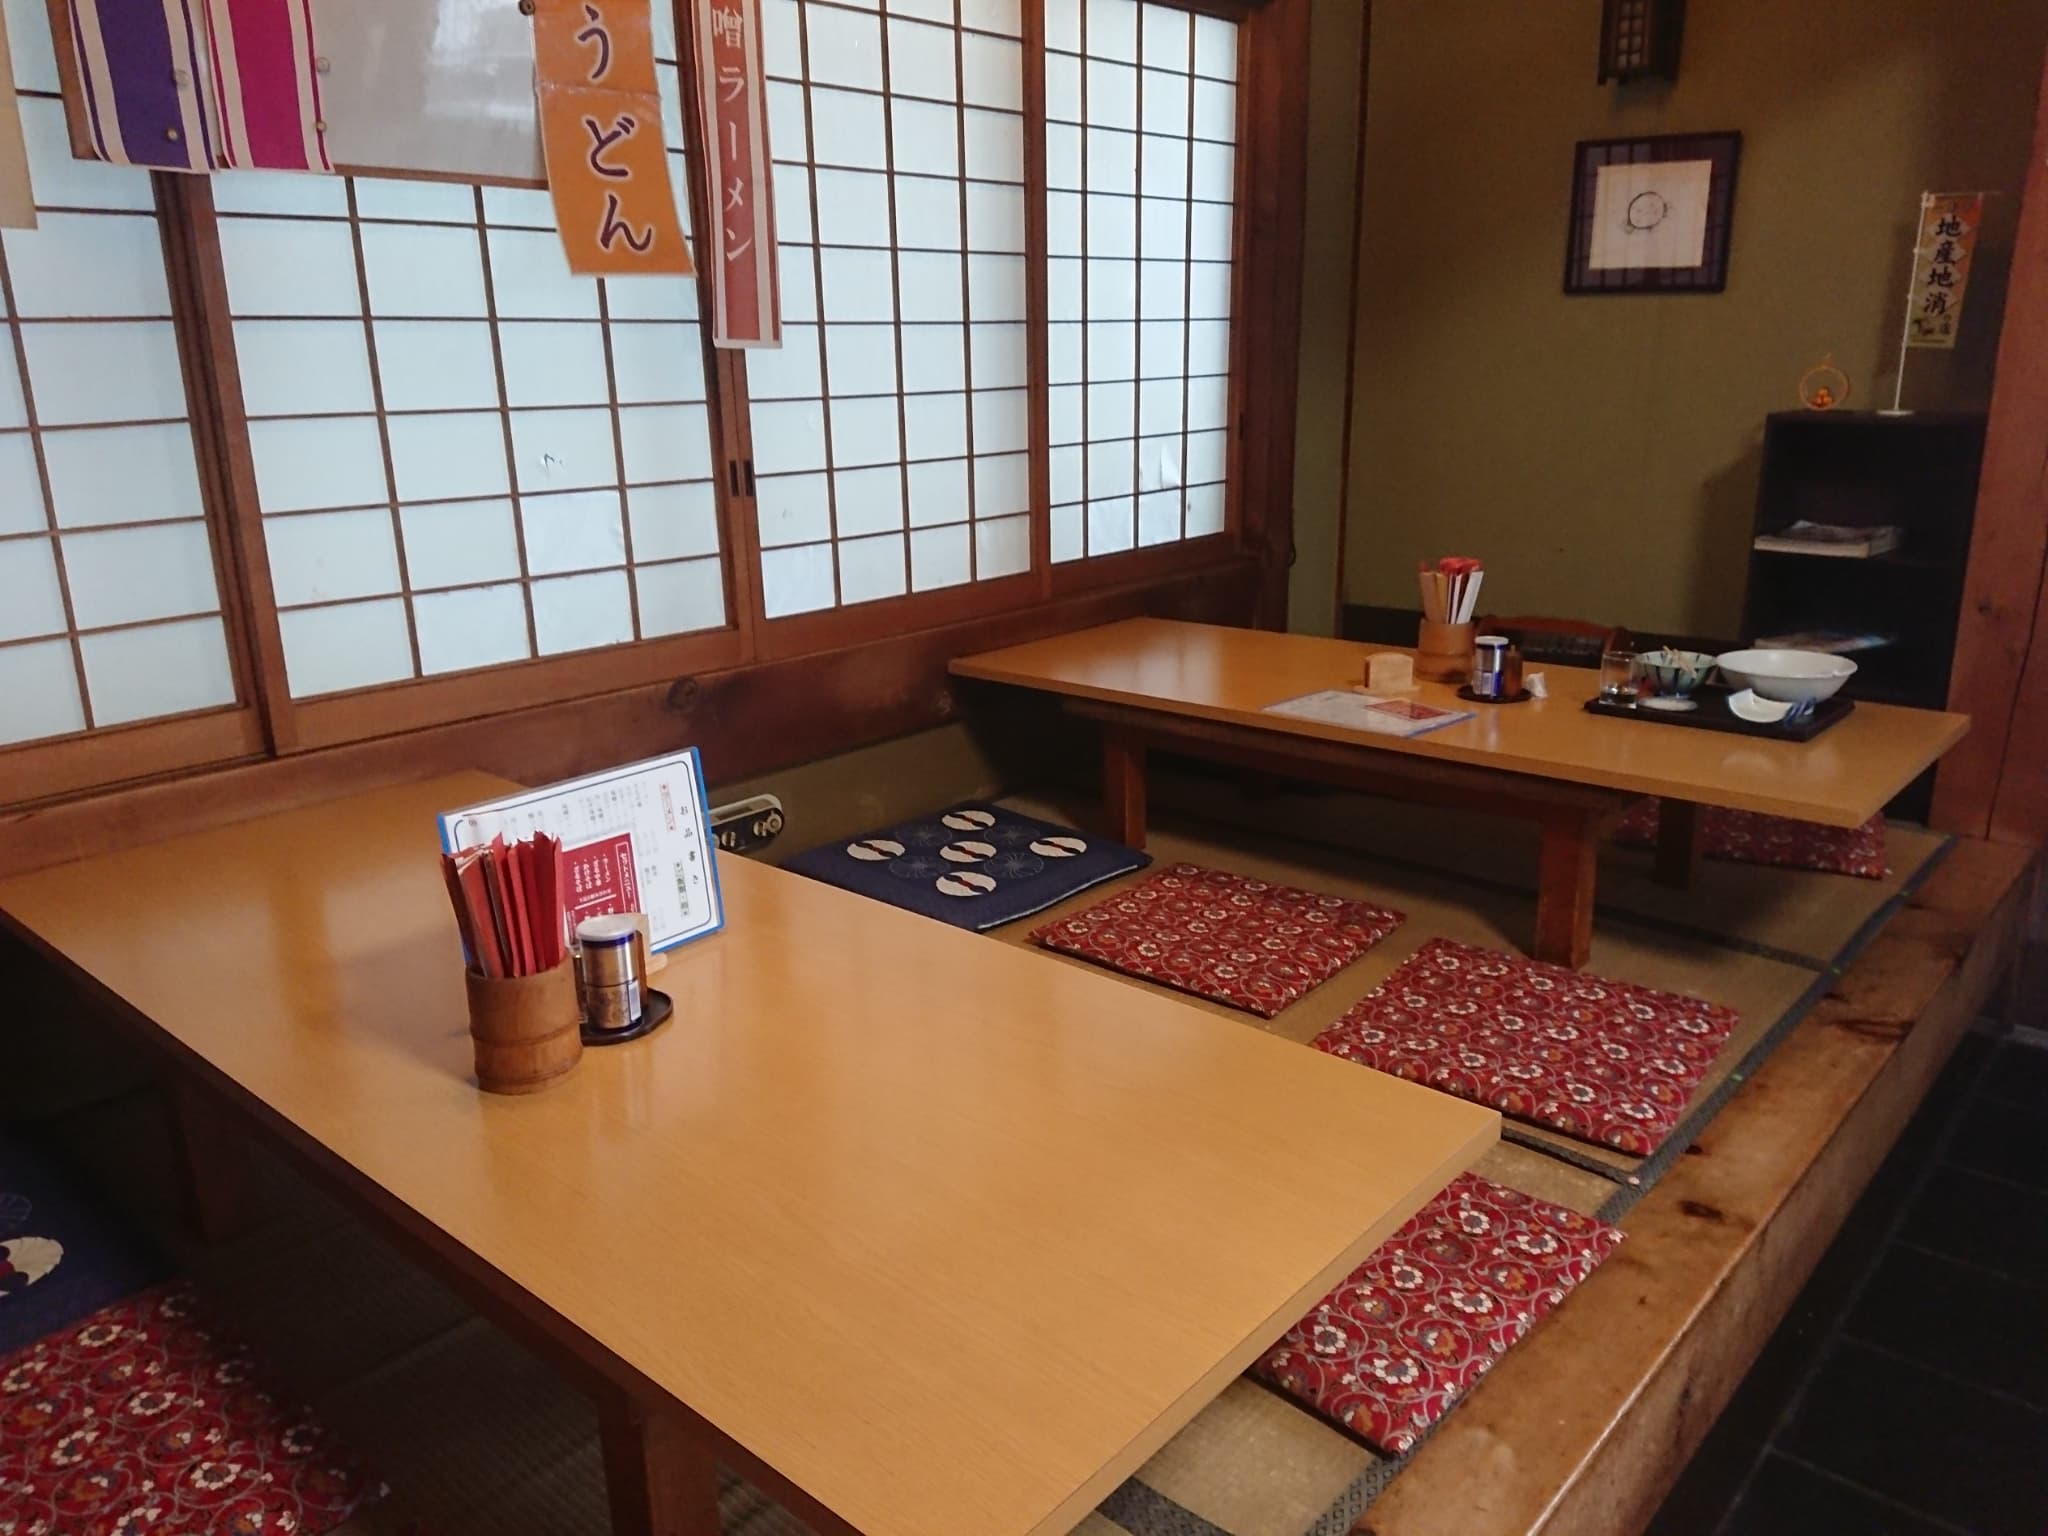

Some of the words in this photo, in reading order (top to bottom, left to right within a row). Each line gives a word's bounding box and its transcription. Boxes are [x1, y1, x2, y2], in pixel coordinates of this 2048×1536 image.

[576, 3, 653, 252] うどん
[711, 5, 752, 262] 噌ラーメン
[1924, 215, 1962, 314] 地産地消
